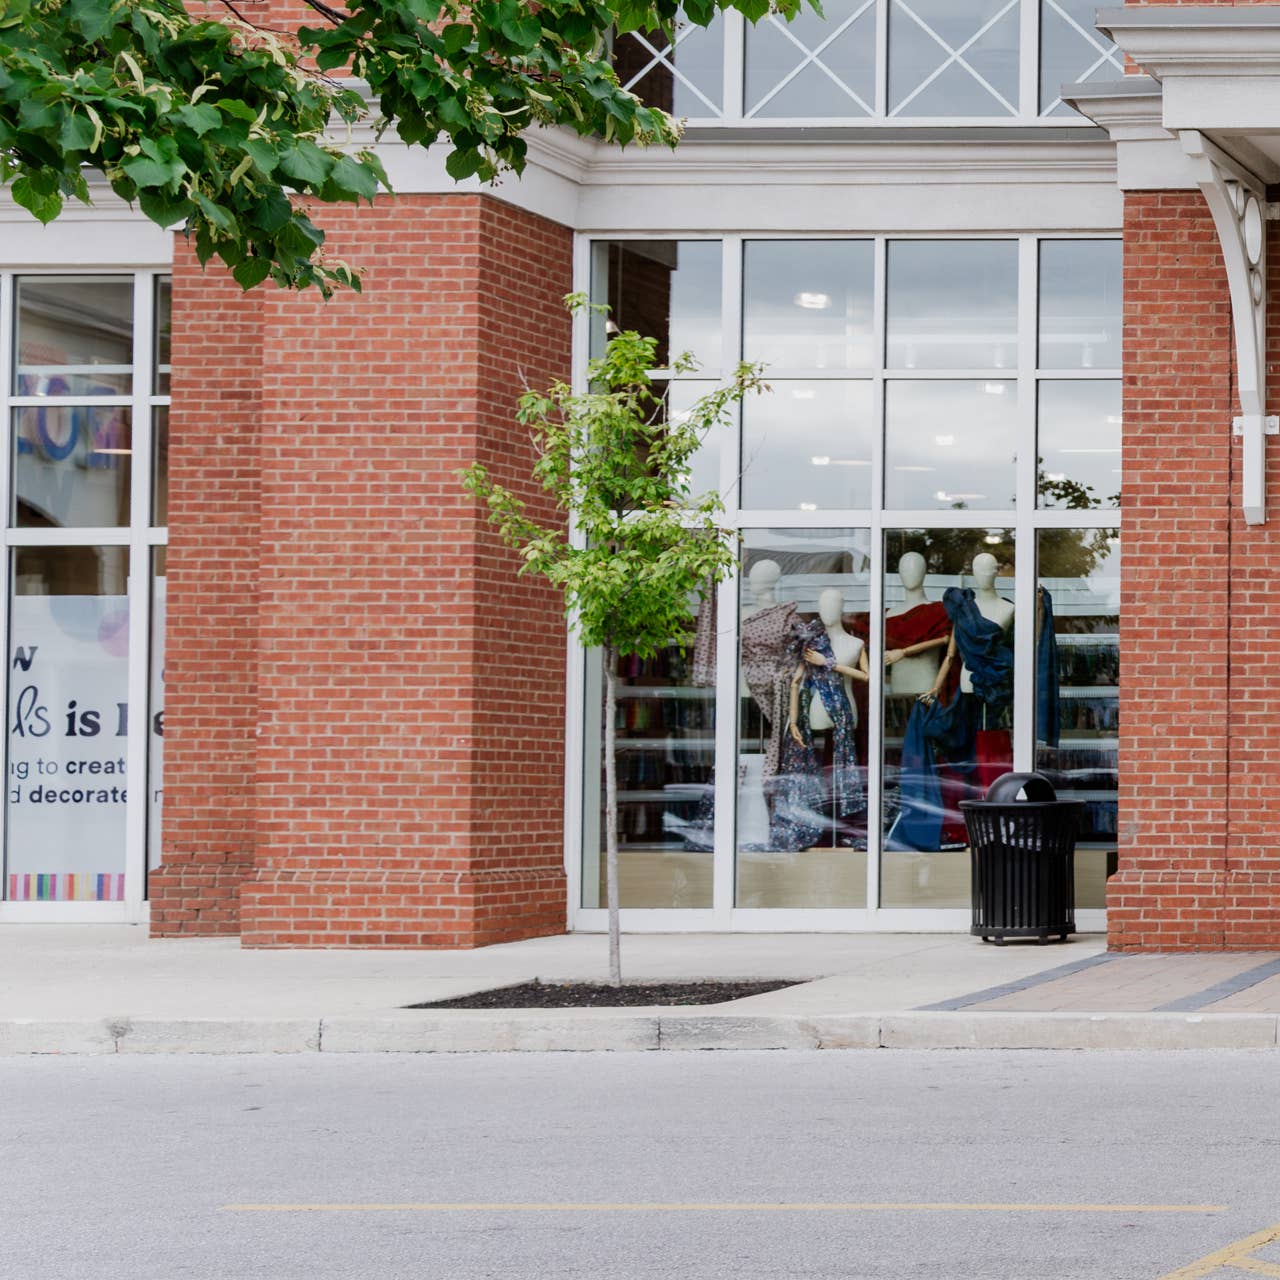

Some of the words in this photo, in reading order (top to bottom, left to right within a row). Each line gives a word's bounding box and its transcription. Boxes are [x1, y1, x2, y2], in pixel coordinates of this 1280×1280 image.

[65, 700, 101, 737] is
[36, 758, 59, 775] to
[66, 758, 126, 775] creat
